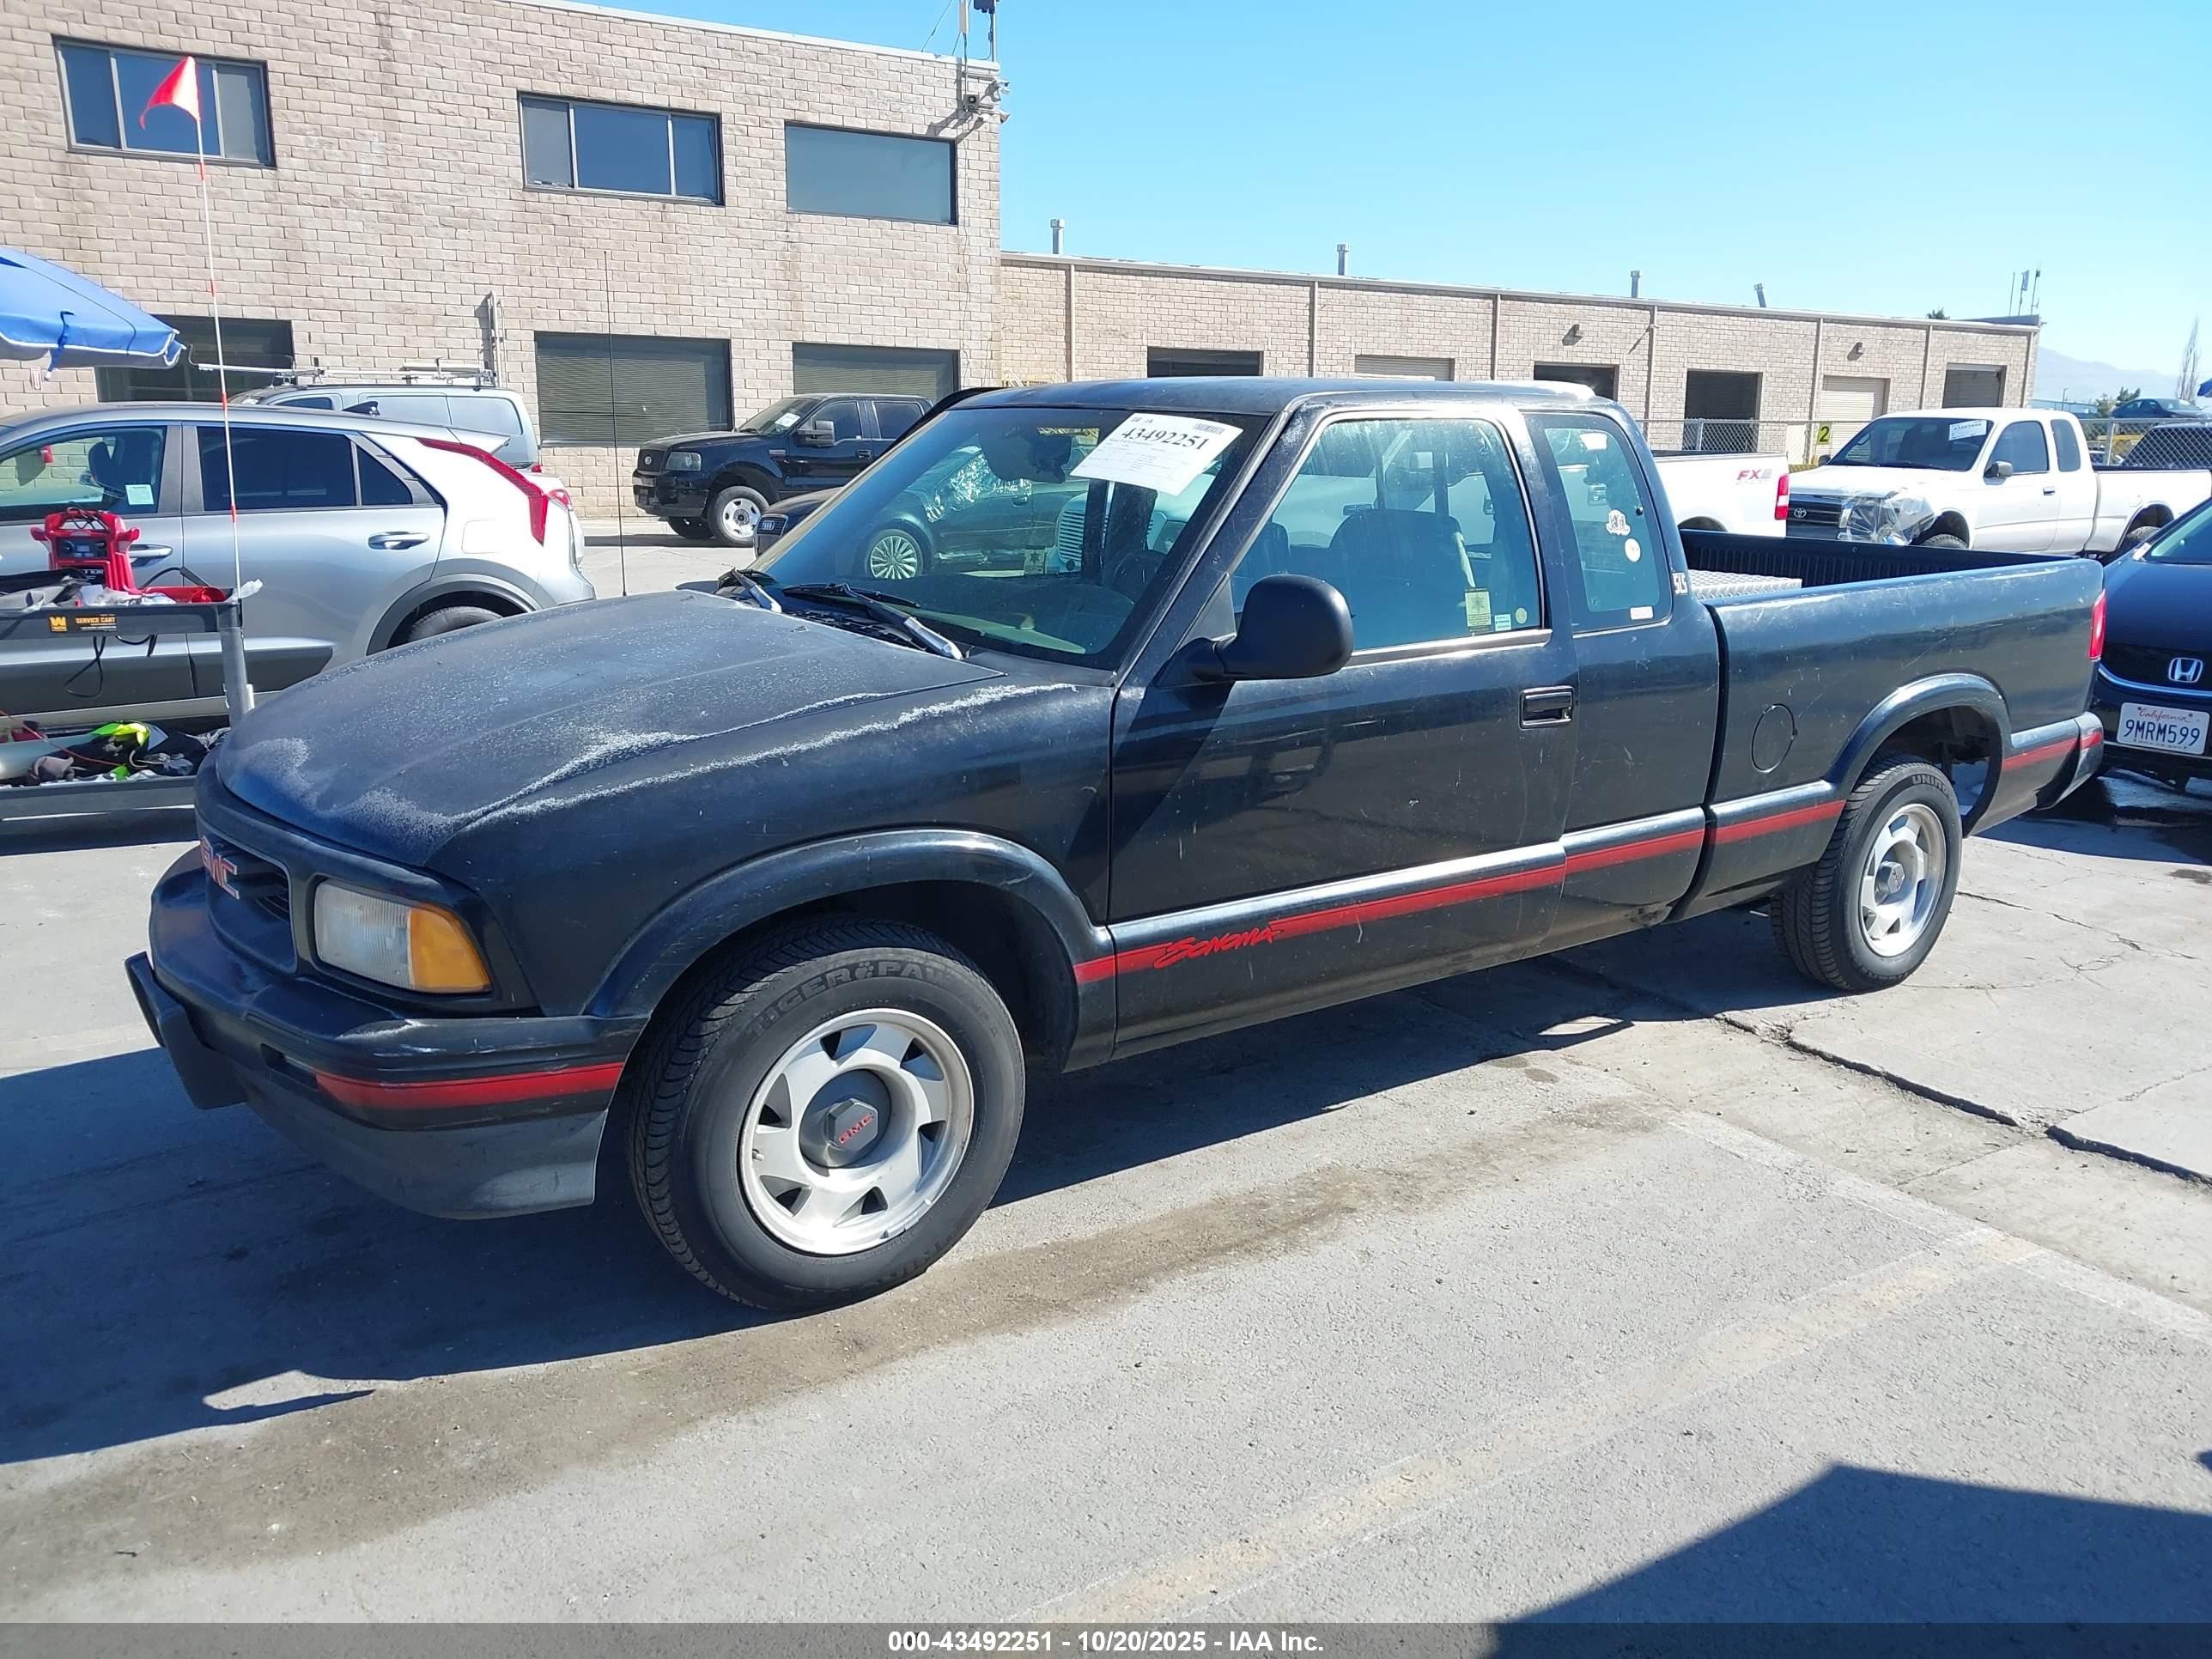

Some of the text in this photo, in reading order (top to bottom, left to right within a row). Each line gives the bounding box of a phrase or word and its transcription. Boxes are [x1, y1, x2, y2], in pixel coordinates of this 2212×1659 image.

[1121, 427, 1209, 450] 43492251
[1820, 426, 1829, 441] 2
[2139, 707, 2191, 723] California
[2124, 720, 2200, 746] 9MRM599
[839, 1115, 873, 1144] GMC
